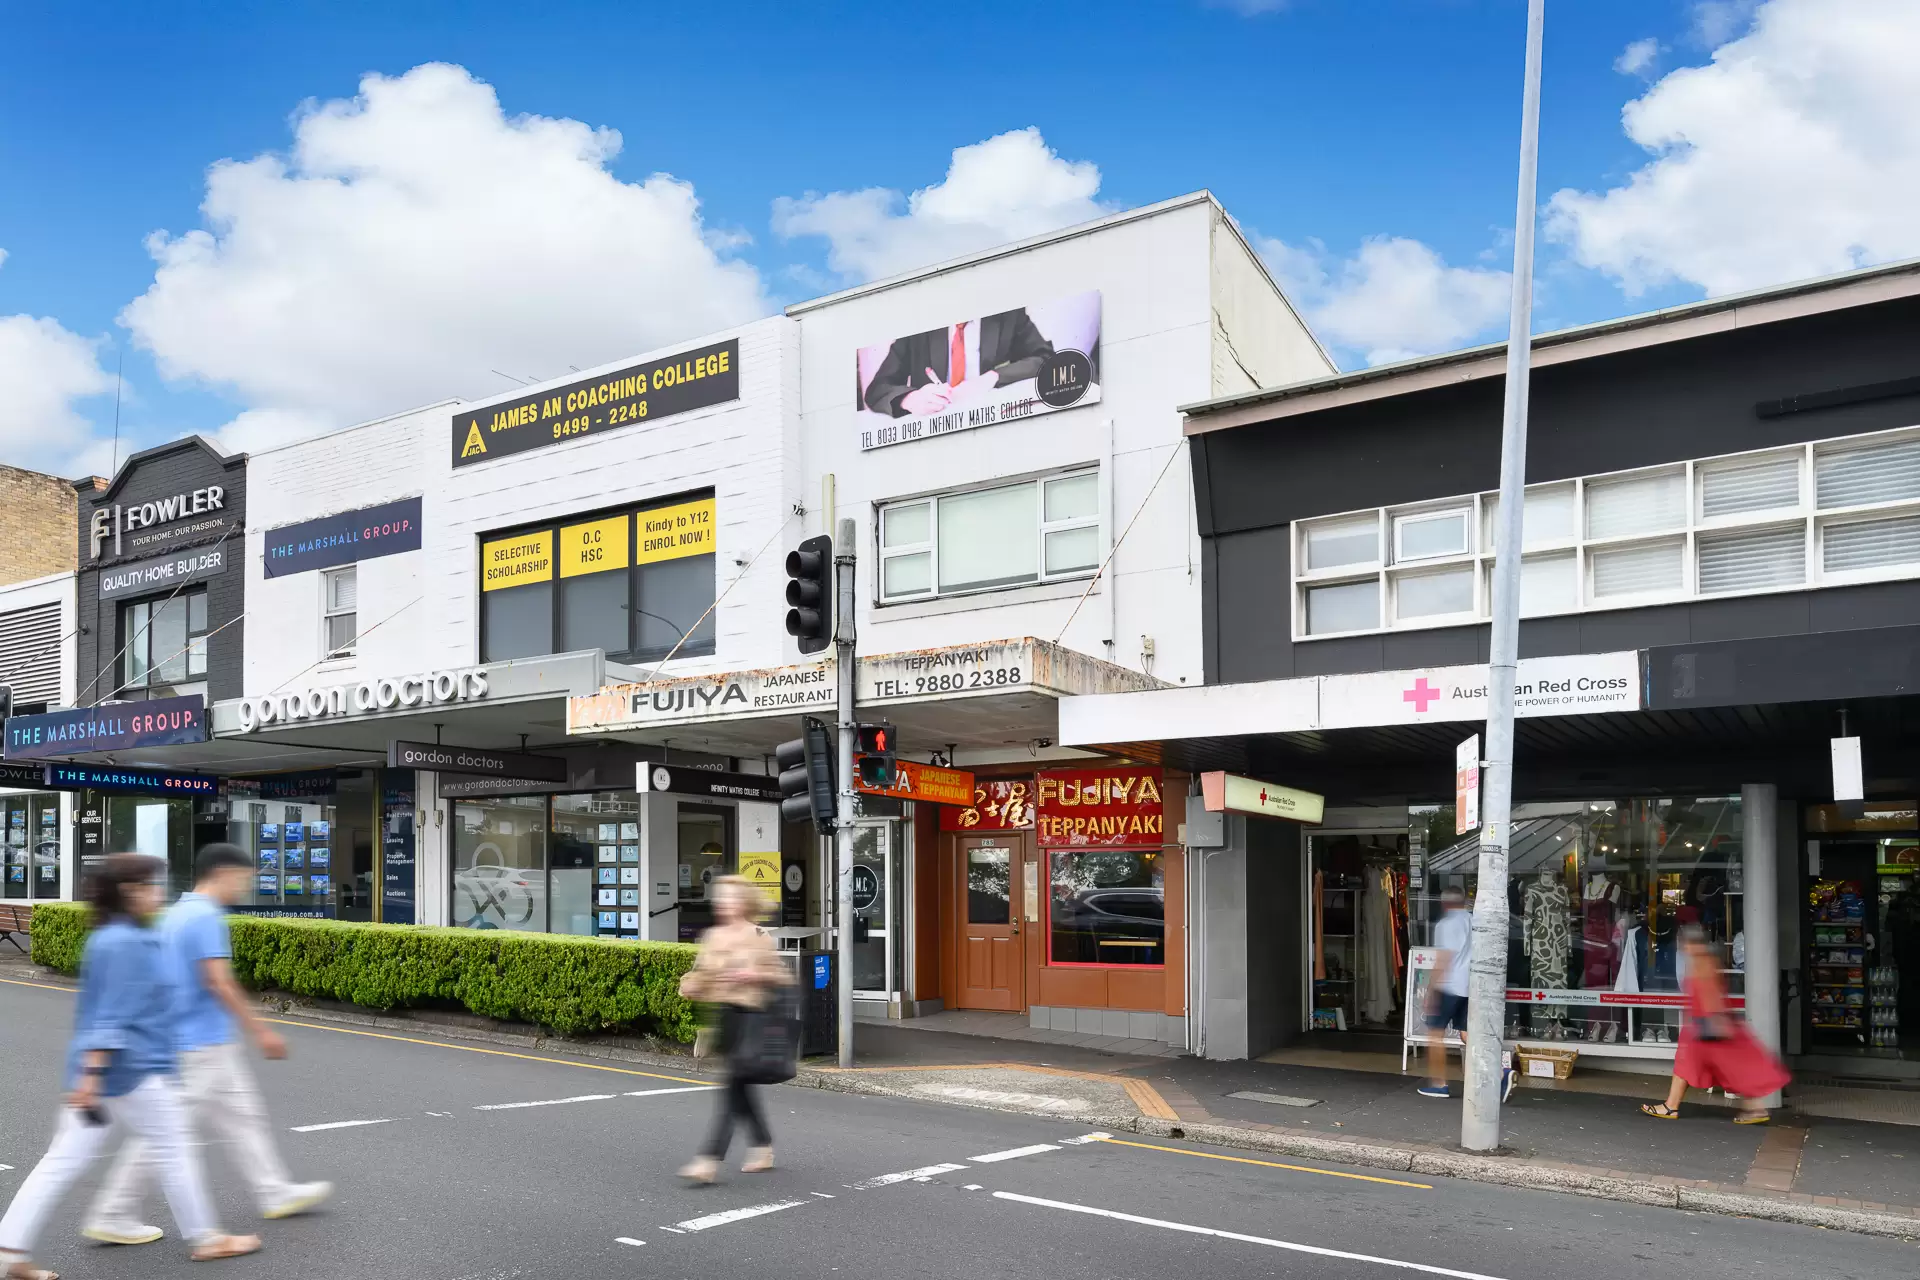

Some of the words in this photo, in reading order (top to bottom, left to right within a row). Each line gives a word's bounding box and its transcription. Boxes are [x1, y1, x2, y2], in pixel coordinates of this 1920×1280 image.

[1053, 365, 1076, 387] I.M.C
[490, 403, 537, 433] JAMES
[542, 397, 561, 420] AN
[566, 374, 647, 412] COACHING
[653, 351, 729, 390] COLLEGE
[553, 416, 589, 438] 9499
[609, 401, 648, 425] 2248
[861, 432, 873, 448] TEL
[877, 428, 897, 445] 8033
[902, 421, 922, 440] 0482
[929, 412, 964, 435] INFINITY
[969, 406, 996, 426] MATHS
[1000, 398, 1034, 420] COLLEGE
[467, 445, 480, 456] JAC
[127, 485, 224, 530] FOWLER
[132, 537, 151, 547] YOUR
[151, 530, 174, 542] HOME.
[175, 526, 190, 536] OUR
[191, 518, 225, 533] PASSION.
[645, 518, 673, 534] Kindy
[677, 516, 686, 528] to
[690, 511, 709, 525] Y12
[271, 544, 294, 559] THE
[298, 531, 359, 554] MARSHALL
[363, 520, 413, 540] GROUP.
[583, 530, 601, 545] O.C
[644, 538, 676, 552] ENROL
[679, 532, 704, 546] NOW
[494, 542, 541, 562] SELECTIVE
[581, 547, 603, 563] HSC
[103, 570, 143, 592] QUALITY
[145, 562, 174, 582] HOME
[177, 552, 222, 575] BUILDER
[487, 559, 549, 580] SCHOLARSHIP
[904, 650, 989, 671] TEPPANYAKI
[763, 670, 825, 688] JAPANESE
[875, 680, 909, 697] TEL:
[915, 673, 964, 692] 9880
[969, 667, 1021, 688] 2388
[1538, 679, 1571, 693] Red
[1577, 677, 1627, 691] Cross
[238, 684, 347, 733] gordon
[354, 667, 488, 712] doctors
[632, 683, 748, 714] FUJIYA
[754, 689, 833, 707] RESTAURANT
[1525, 698, 1560, 706] POWER
[1562, 696, 1574, 704] OF
[1577, 693, 1627, 703] HUMANITY
[13, 727, 41, 746] THE
[47, 718, 125, 743] MARSHALL
[132, 710, 198, 733] GROUP.
[404, 749, 452, 763] gordon
[457, 753, 504, 769] doctors
[58, 770, 86, 781] THE
[92, 773, 160, 786] MARSHALL
[164, 778, 213, 790] GROUP.
[919, 769, 961, 786] JAPANESE
[711, 784, 728, 793] INFINITY
[744, 787, 760, 797] COLLEGE
[919, 782, 968, 800] TEPPANYAKI
[1038, 776, 1161, 807] FUJIYA
[81, 816, 102, 824] SERVICES
[1039, 814, 1163, 837] TEPPANYAKI
